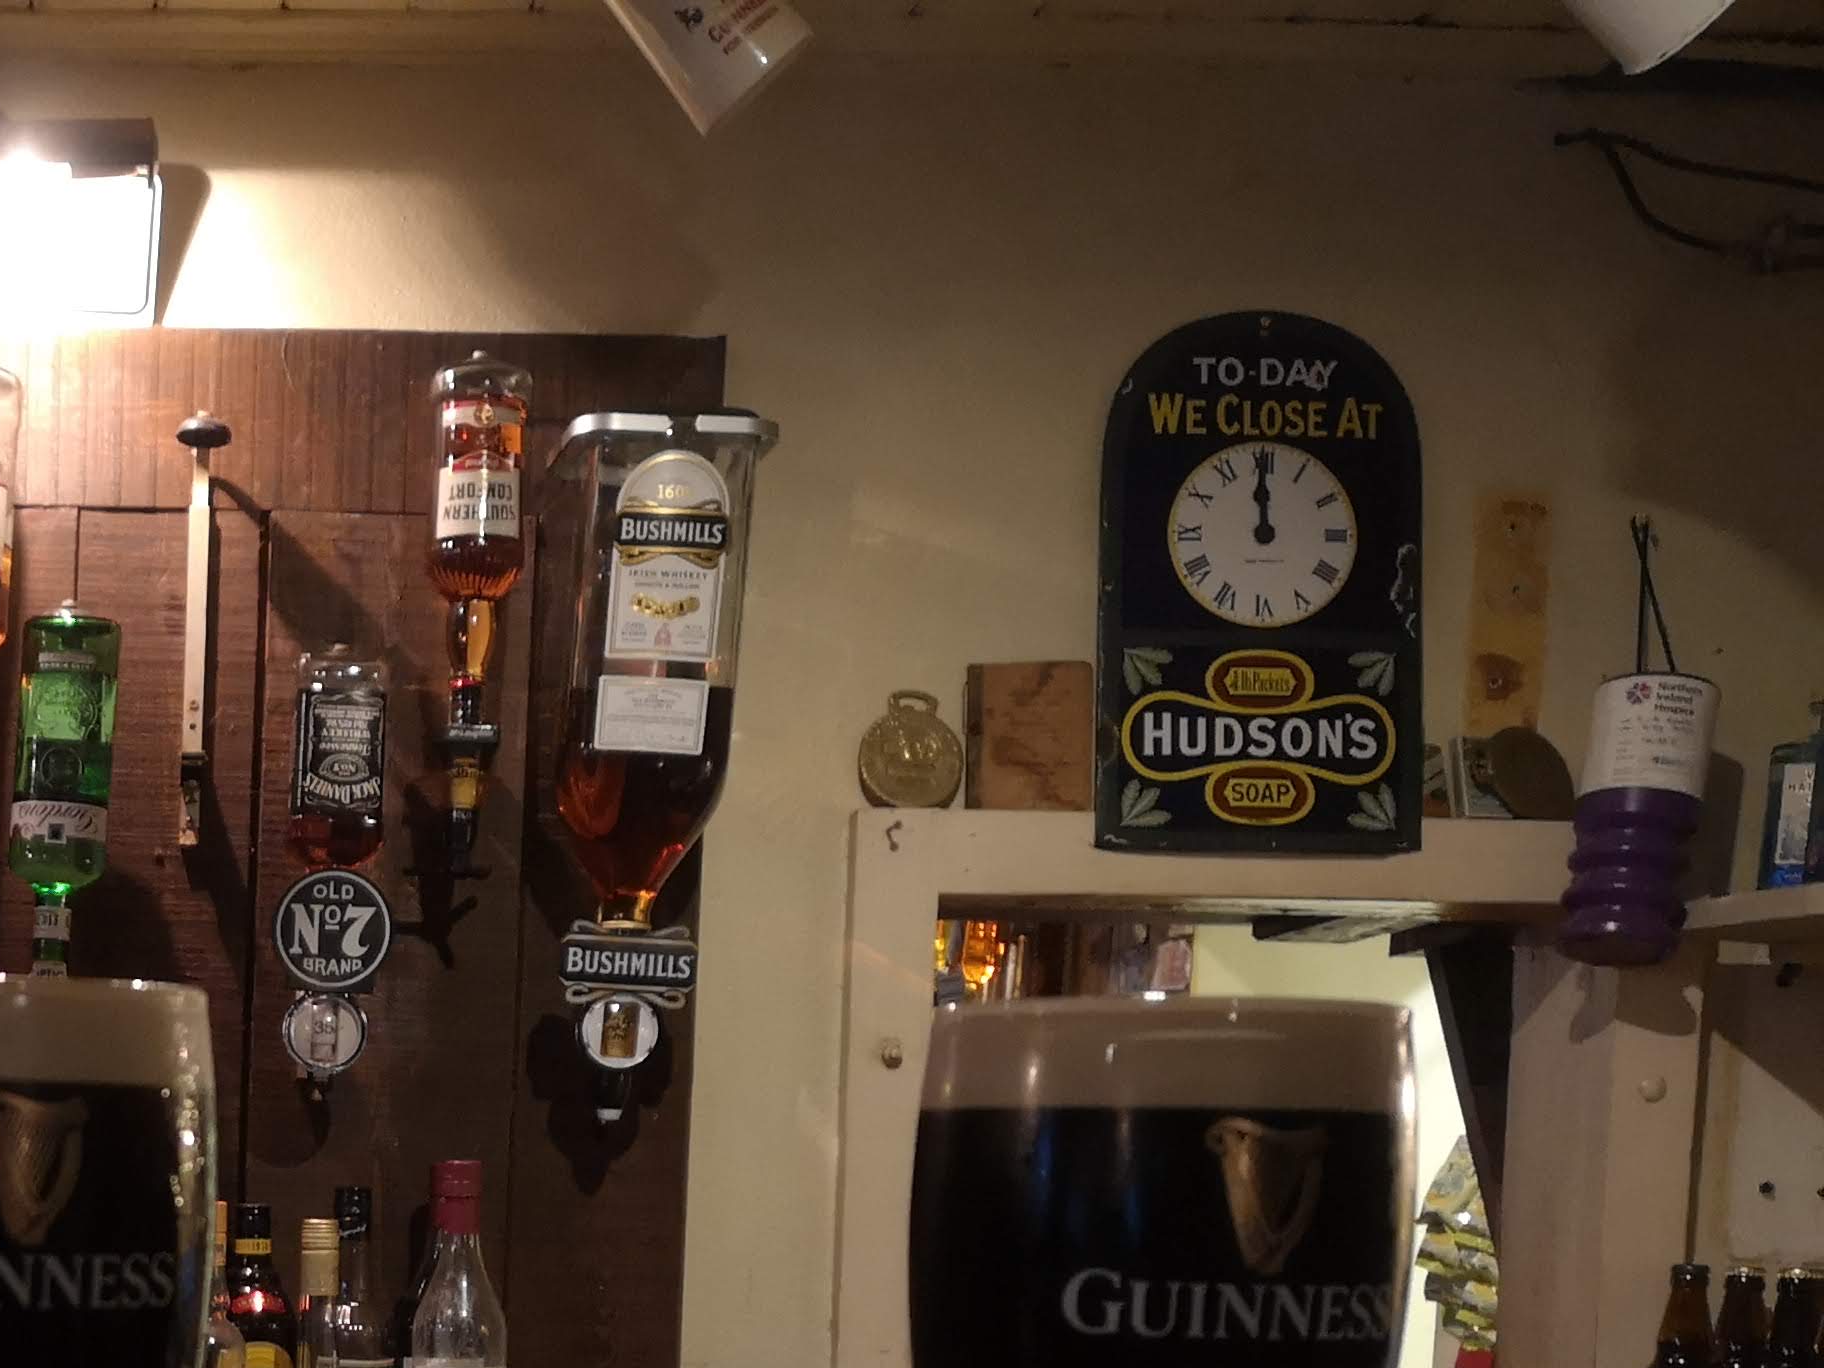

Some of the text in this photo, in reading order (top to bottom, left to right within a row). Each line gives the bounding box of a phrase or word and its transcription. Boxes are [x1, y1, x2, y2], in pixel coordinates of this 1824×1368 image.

[1192, 356, 1339, 391] TO-DAY
[1148, 391, 1384, 440] WE CLOSE AT
[619, 517, 726, 545] BUSHMILLS
[1142, 711, 1379, 759] HUDSON'S
[351, 776, 382, 799] JACK
[1231, 782, 1290, 804] SOAP
[312, 880, 355, 901] OLD
[302, 957, 363, 977] BRAND
[566, 945, 692, 979] BUSHMILLS
[1060, 1266, 1394, 1342] GUINNESS
